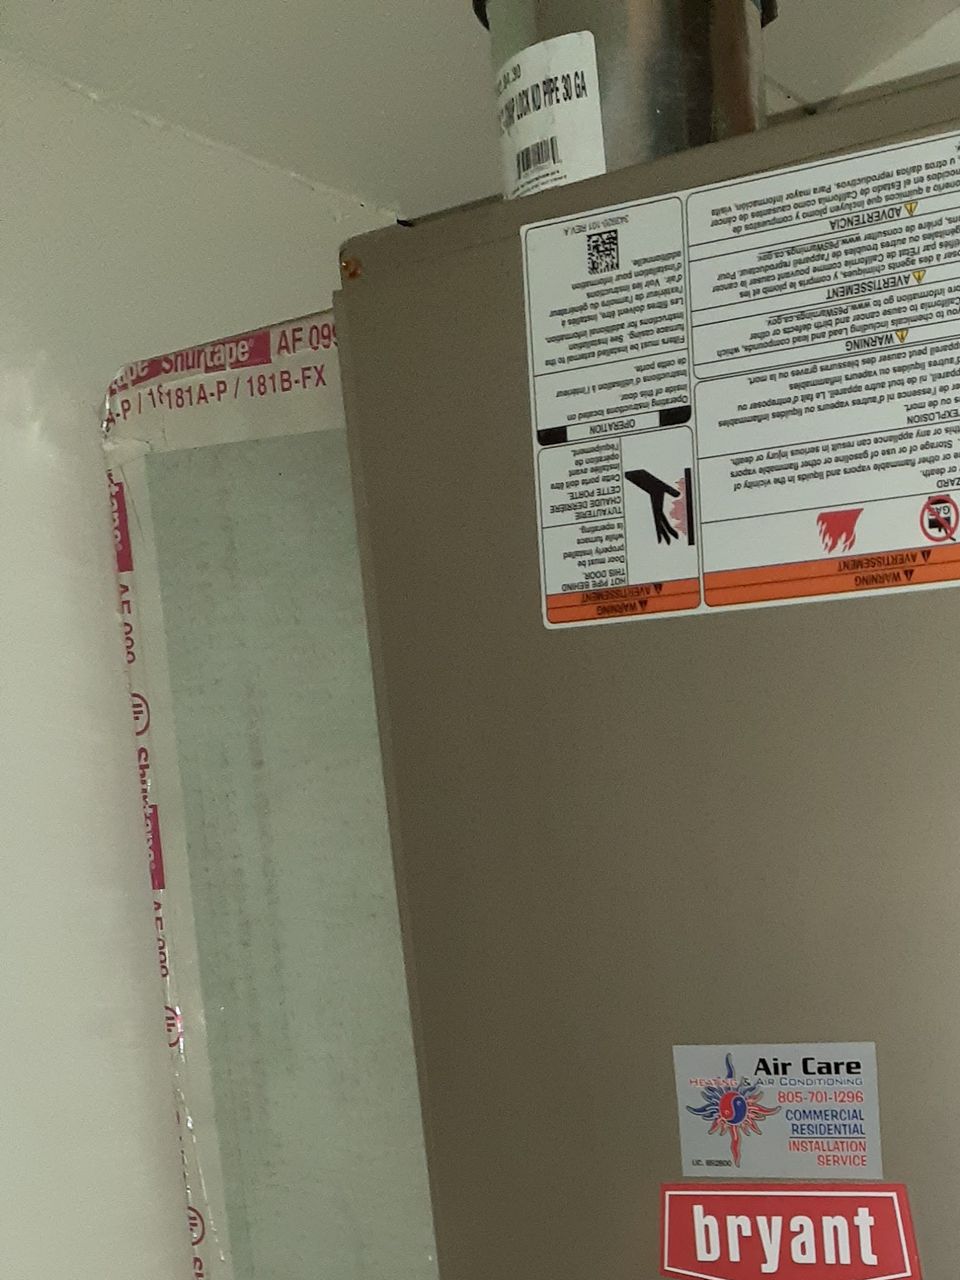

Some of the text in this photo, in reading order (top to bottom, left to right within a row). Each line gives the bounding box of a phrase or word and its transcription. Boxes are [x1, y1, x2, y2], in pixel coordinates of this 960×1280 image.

[562, 73, 573, 103] 30
[574, 70, 588, 99] GA
[828, 205, 902, 230] ADVERTENCIA
[826, 273, 911, 299] AVERTISSEMENT
[895, 287, 945, 306] information
[851, 310, 880, 322] cancer
[880, 305, 908, 317] cause
[812, 318, 833, 331] birth
[833, 315, 850, 328] and
[849, 317, 889, 336] including
[889, 311, 934, 329] chemicals
[749, 329, 771, 342] other
[781, 322, 812, 337] defects
[809, 330, 826, 343] and
[826, 326, 849, 340] Lead
[277, 326, 303, 356] AF
[791, 333, 809, 346] lead
[844, 333, 894, 351] WARNING
[715, 346, 740, 359] which
[166, 379, 229, 410] 181A-P
[246, 363, 328, 398] 181B-FX
[588, 417, 636, 435] OPERATION
[914, 426, 931, 438] any
[943, 424, 960, 436] this
[855, 437, 872, 447] can
[872, 428, 914, 446] appliance
[789, 444, 820, 458] serious
[830, 439, 855, 452] result
[918, 436, 953, 453] Storage
[765, 447, 788, 462] injury
[832, 448, 869, 465] gasoline
[880, 447, 896, 457] use
[799, 457, 822, 470] other
[871, 457, 916, 473] flammable
[916, 453, 940, 466] other
[729, 464, 757, 478] vapors
[757, 460, 799, 476] flammable
[796, 467, 824, 483] liquids
[824, 467, 841, 479] and
[842, 461, 871, 475] vapors
[918, 465, 946, 479] death.
[742, 475, 771, 490] vicinity
[772, 475, 786, 486] the
[595, 484, 621, 496] CETTE
[589, 494, 621, 508] CHAUDE
[573, 505, 622, 520] TUYAUTERIE
[837, 552, 917, 572] AVERTISSEMENT
[607, 566, 625, 577] THIS
[853, 571, 901, 586] WARNING
[560, 575, 625, 592] HOT PIPE BEHIND
[579, 584, 650, 603] AVERTISSEMENT
[595, 600, 637, 615] WARNING
[754, 1057, 862, 1076] Air Care
[777, 1090, 865, 1104] 805-701-1296
[785, 1108, 865, 1121] COMMERCIAL
[791, 1123, 866, 1136] RESIDENTIAL
[788, 1140, 867, 1153] INSTALLATION
[817, 1154, 867, 1167] SERVICE
[693, 1205, 878, 1273] bryant
